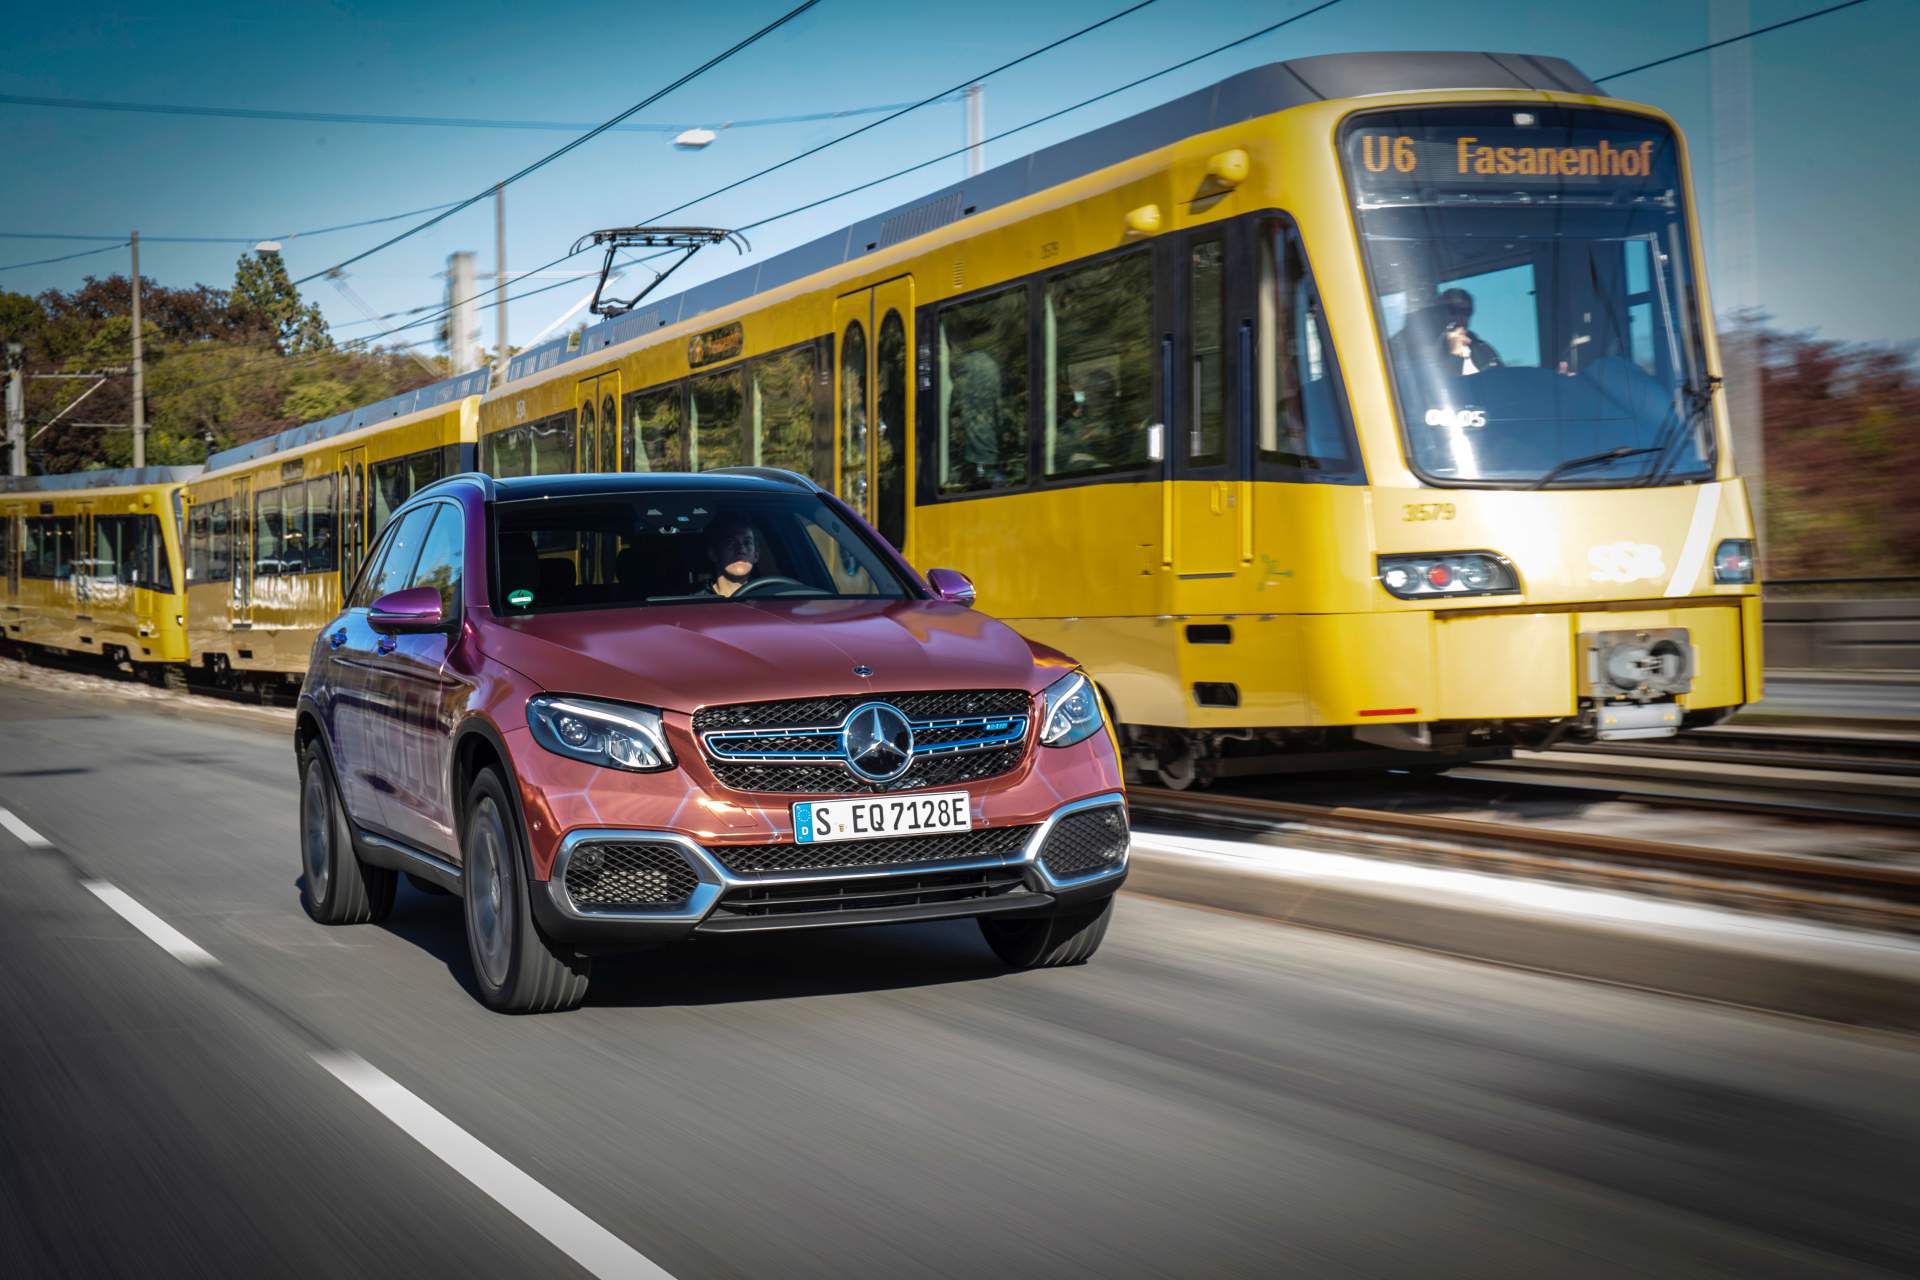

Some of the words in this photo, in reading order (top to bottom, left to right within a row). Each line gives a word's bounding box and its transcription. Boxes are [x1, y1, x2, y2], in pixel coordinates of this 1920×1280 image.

[1361, 135, 1417, 173] U6
[1456, 137, 1655, 177] Fasanenhof
[1401, 502, 1457, 522] 3579
[801, 826, 809, 836] D
[816, 807, 831, 836] S
